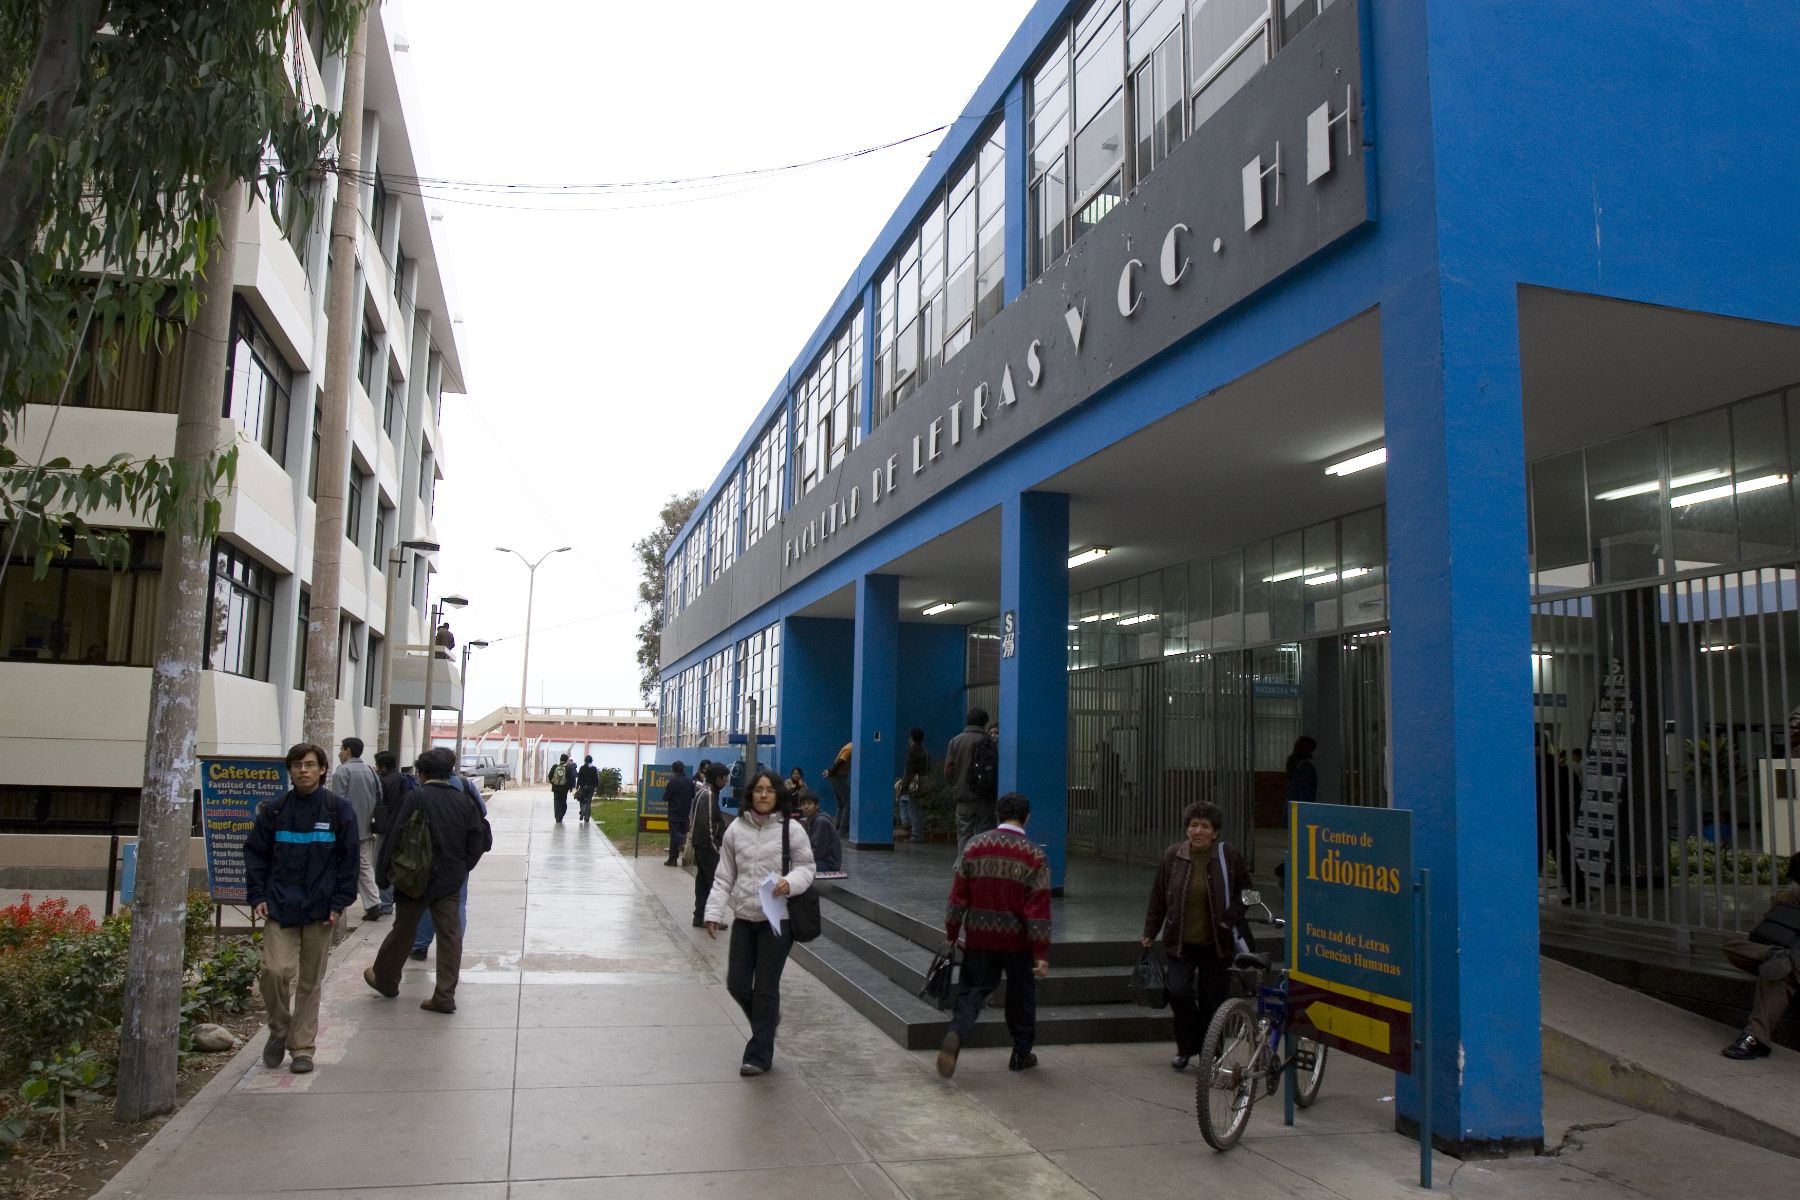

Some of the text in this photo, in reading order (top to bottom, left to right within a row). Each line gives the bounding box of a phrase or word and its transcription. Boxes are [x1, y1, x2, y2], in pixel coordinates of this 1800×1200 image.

[784, 485, 861, 568] FACULTAD
[872, 453, 898, 504] DE
[912, 338, 1041, 475] LETRAS
[1005, 613, 1013, 633] S
[209, 763, 281, 781] Cafetería
[208, 781, 284, 791] Facultad de Letras
[207, 819, 232, 831] Super
[1321, 828, 1374, 848] Centro de
[1305, 824, 1400, 895] Idiomas
[1345, 931, 1357, 946] de
[1358, 934, 1390, 954] Letras
[1304, 944, 1402, 977] y Ciencias Humanas
